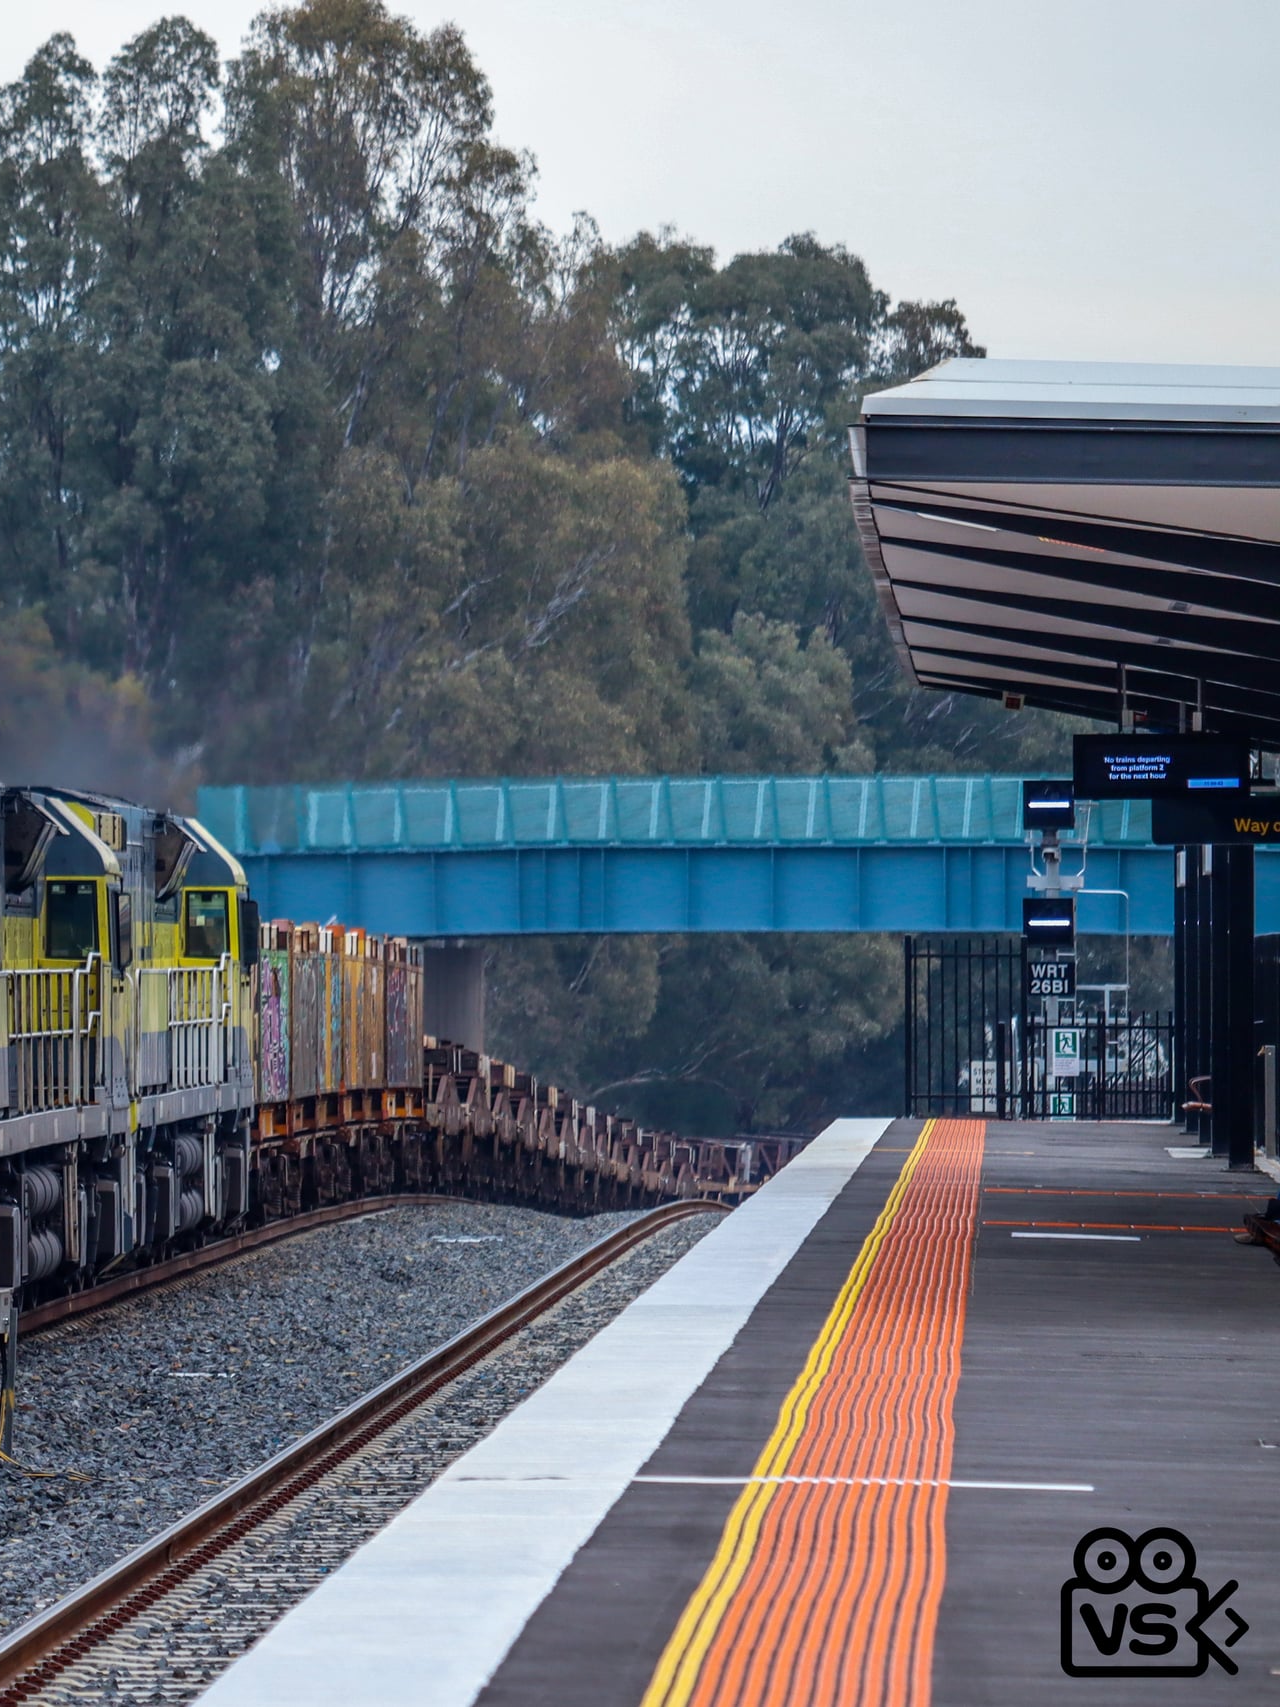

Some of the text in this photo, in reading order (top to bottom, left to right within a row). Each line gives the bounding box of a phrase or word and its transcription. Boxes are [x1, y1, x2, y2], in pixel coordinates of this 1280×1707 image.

[1137, 756, 1170, 764] departing
[1128, 764, 1158, 772] platform
[1234, 818, 1270, 836] Way
[1031, 964, 1068, 978] WRT
